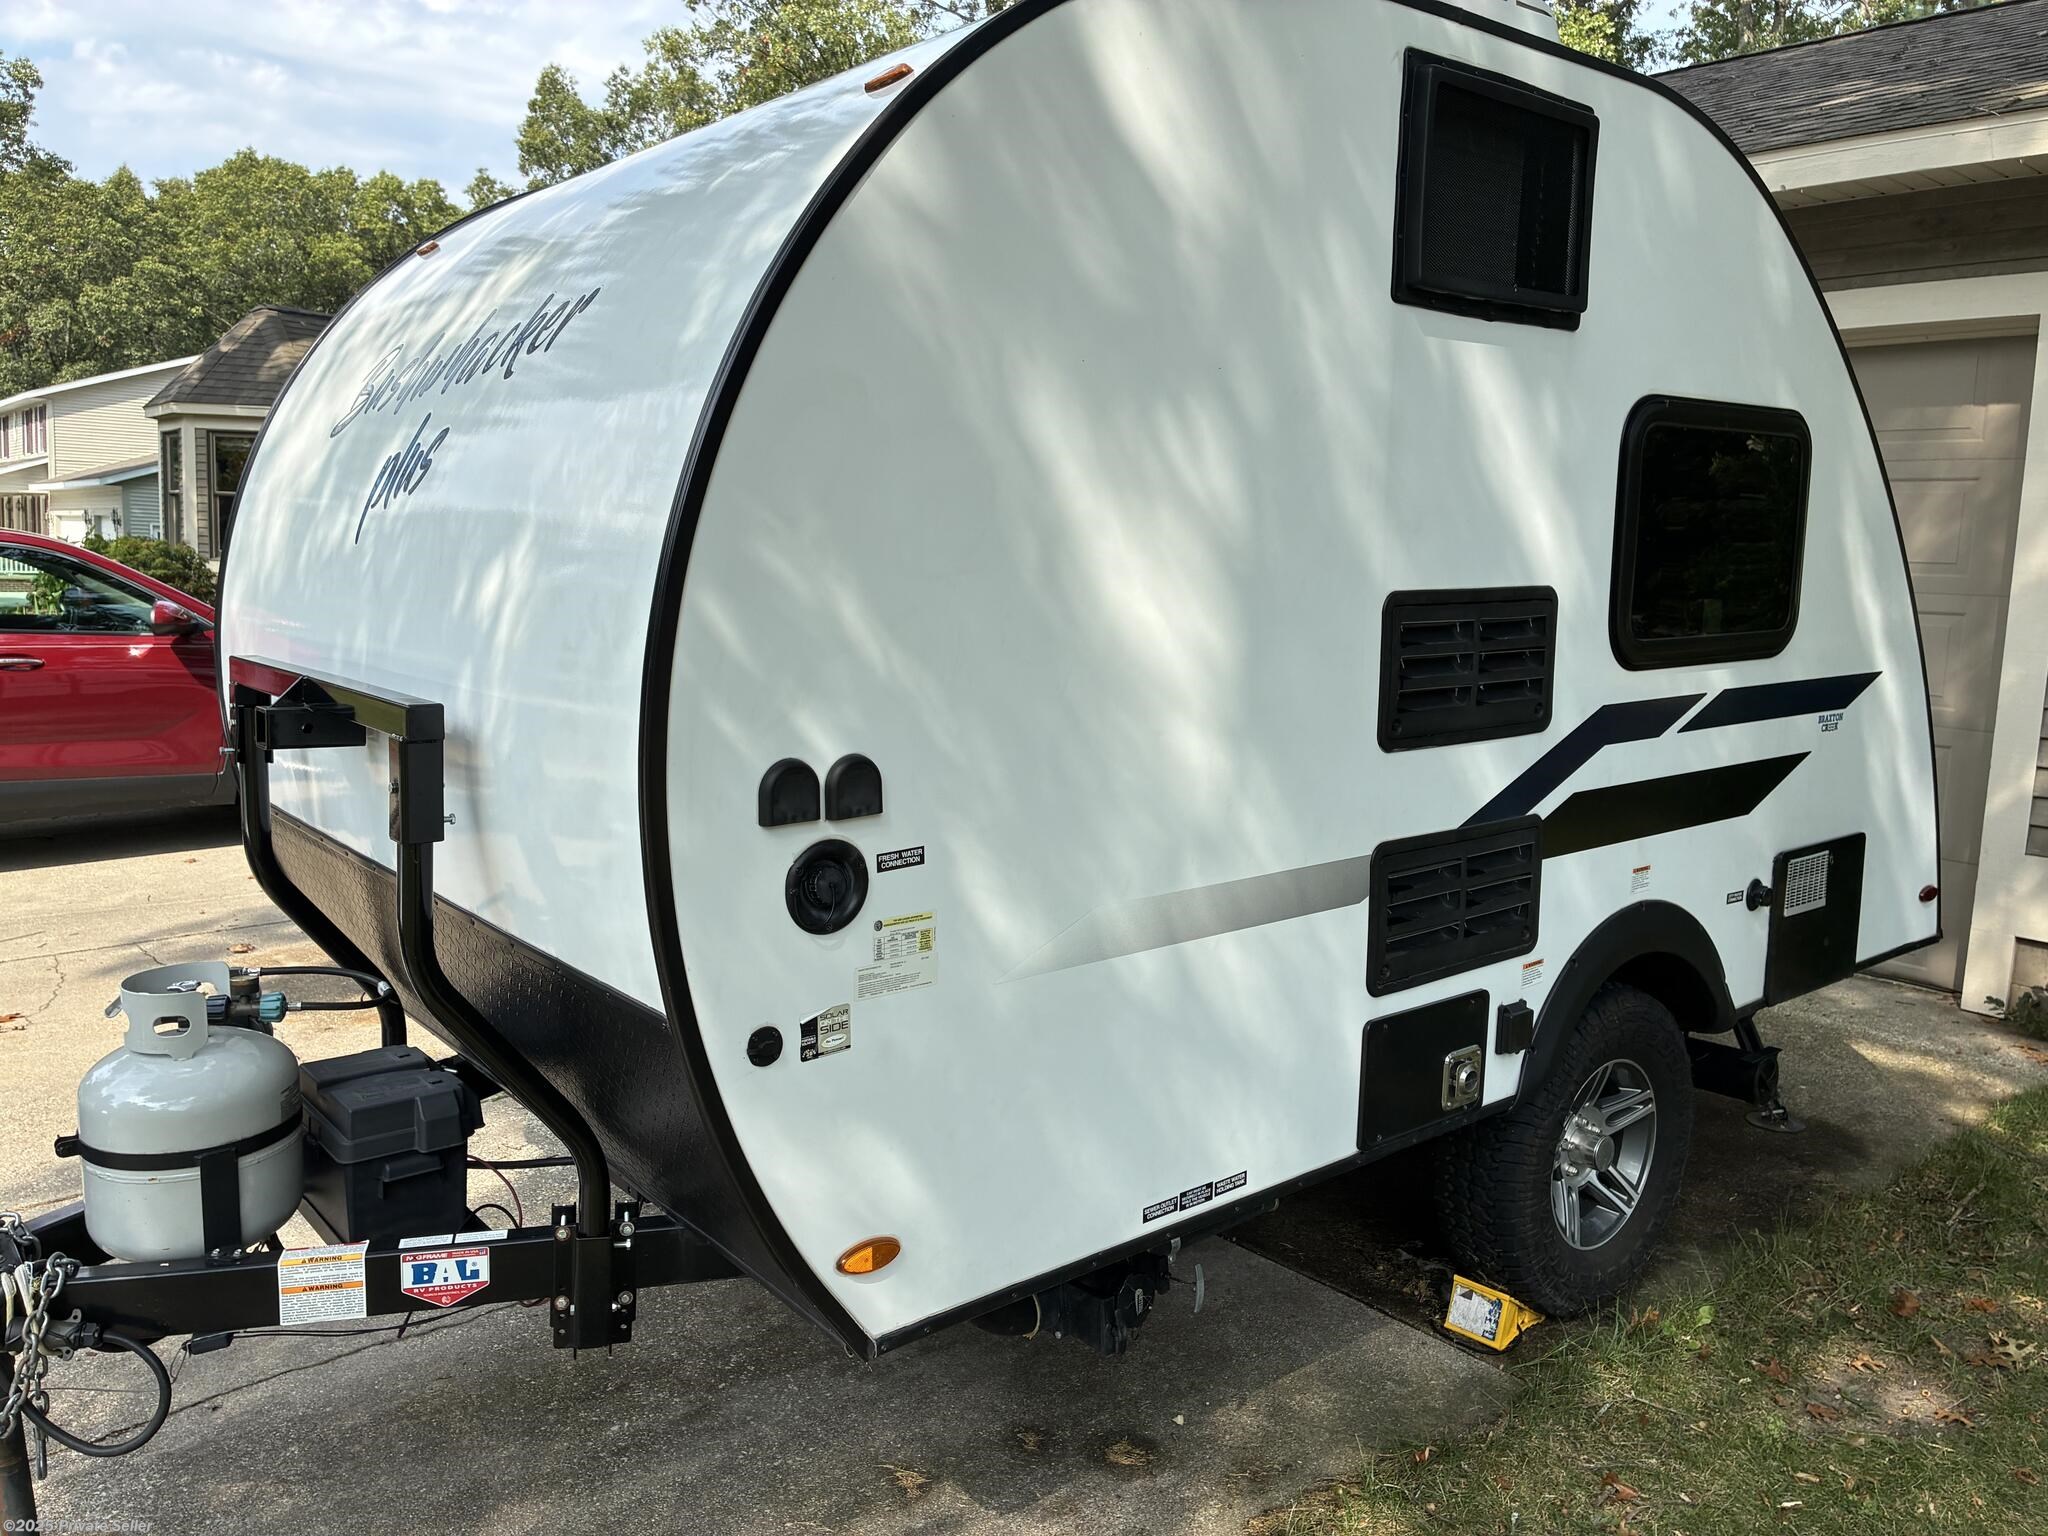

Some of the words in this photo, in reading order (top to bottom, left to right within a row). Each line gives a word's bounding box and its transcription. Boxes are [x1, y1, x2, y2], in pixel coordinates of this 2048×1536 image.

[355, 412, 450, 544] plus
[1818, 712, 1843, 724] BRAXTON
[1821, 722, 1839, 732] CREEK
[878, 852, 899, 862] FRESH
[901, 848, 923, 858] WATER
[880, 856, 921, 869] CONNECTION
[820, 1008, 849, 1020] SOLAR
[820, 1020, 849, 1035] SIDE
[1216, 1179, 1231, 1188] WASTE
[1231, 1173, 1246, 1183] WATER
[1216, 1183, 1235, 1194] HOLDING
[1234, 1178, 1245, 1189] TANK
[1144, 1203, 1161, 1215] SEWER
[1160, 1198, 1177, 1209] OUTLET
[1146, 1205, 1175, 1220] CONNECTION
[307, 1255, 343, 1263] WARNING
[411, 1259, 480, 1285] BAL
[308, 1283, 343, 1291] WARNING
[428, 1283, 478, 1291] PRODUCTS
